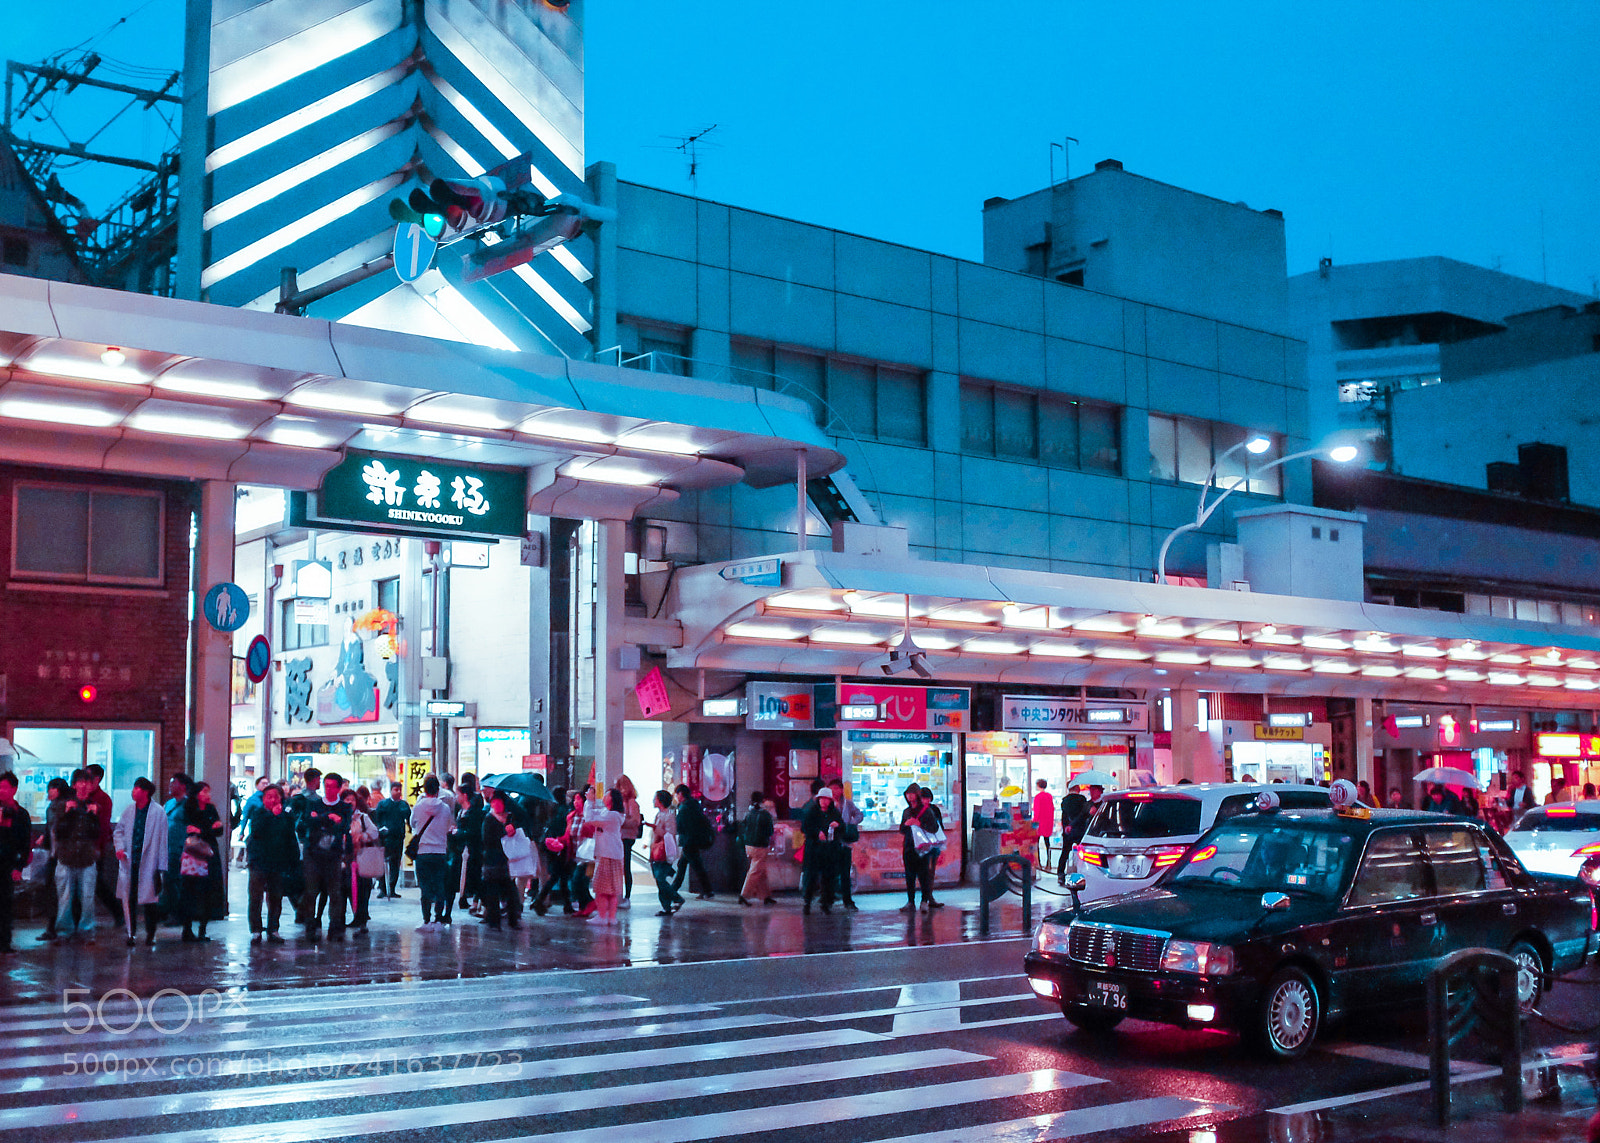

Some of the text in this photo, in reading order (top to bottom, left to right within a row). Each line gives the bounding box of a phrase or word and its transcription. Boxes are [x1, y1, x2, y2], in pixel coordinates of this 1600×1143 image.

[361, 460, 490, 516] 新京極
[388, 508, 464, 526] SHINKYOGOKU
[774, 755, 787, 797] 宝くじ
